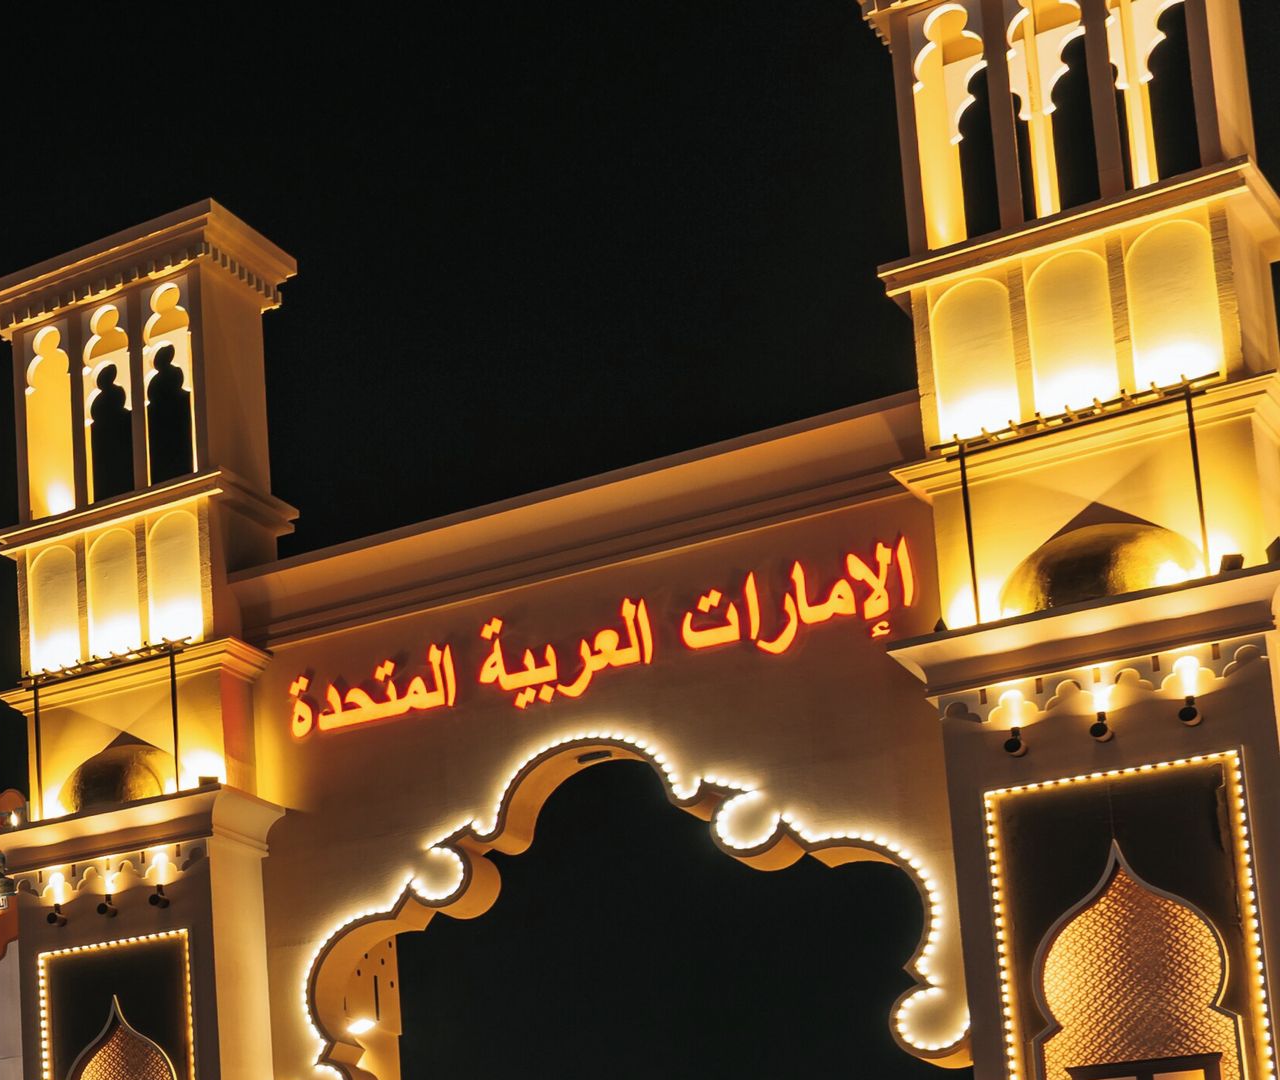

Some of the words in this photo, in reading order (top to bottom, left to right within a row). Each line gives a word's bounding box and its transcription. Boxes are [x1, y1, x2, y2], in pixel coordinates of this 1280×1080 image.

[681, 535, 917, 655] الإمارات
[289, 642, 458, 740] المتحدة
[478, 597, 653, 711] العربية
